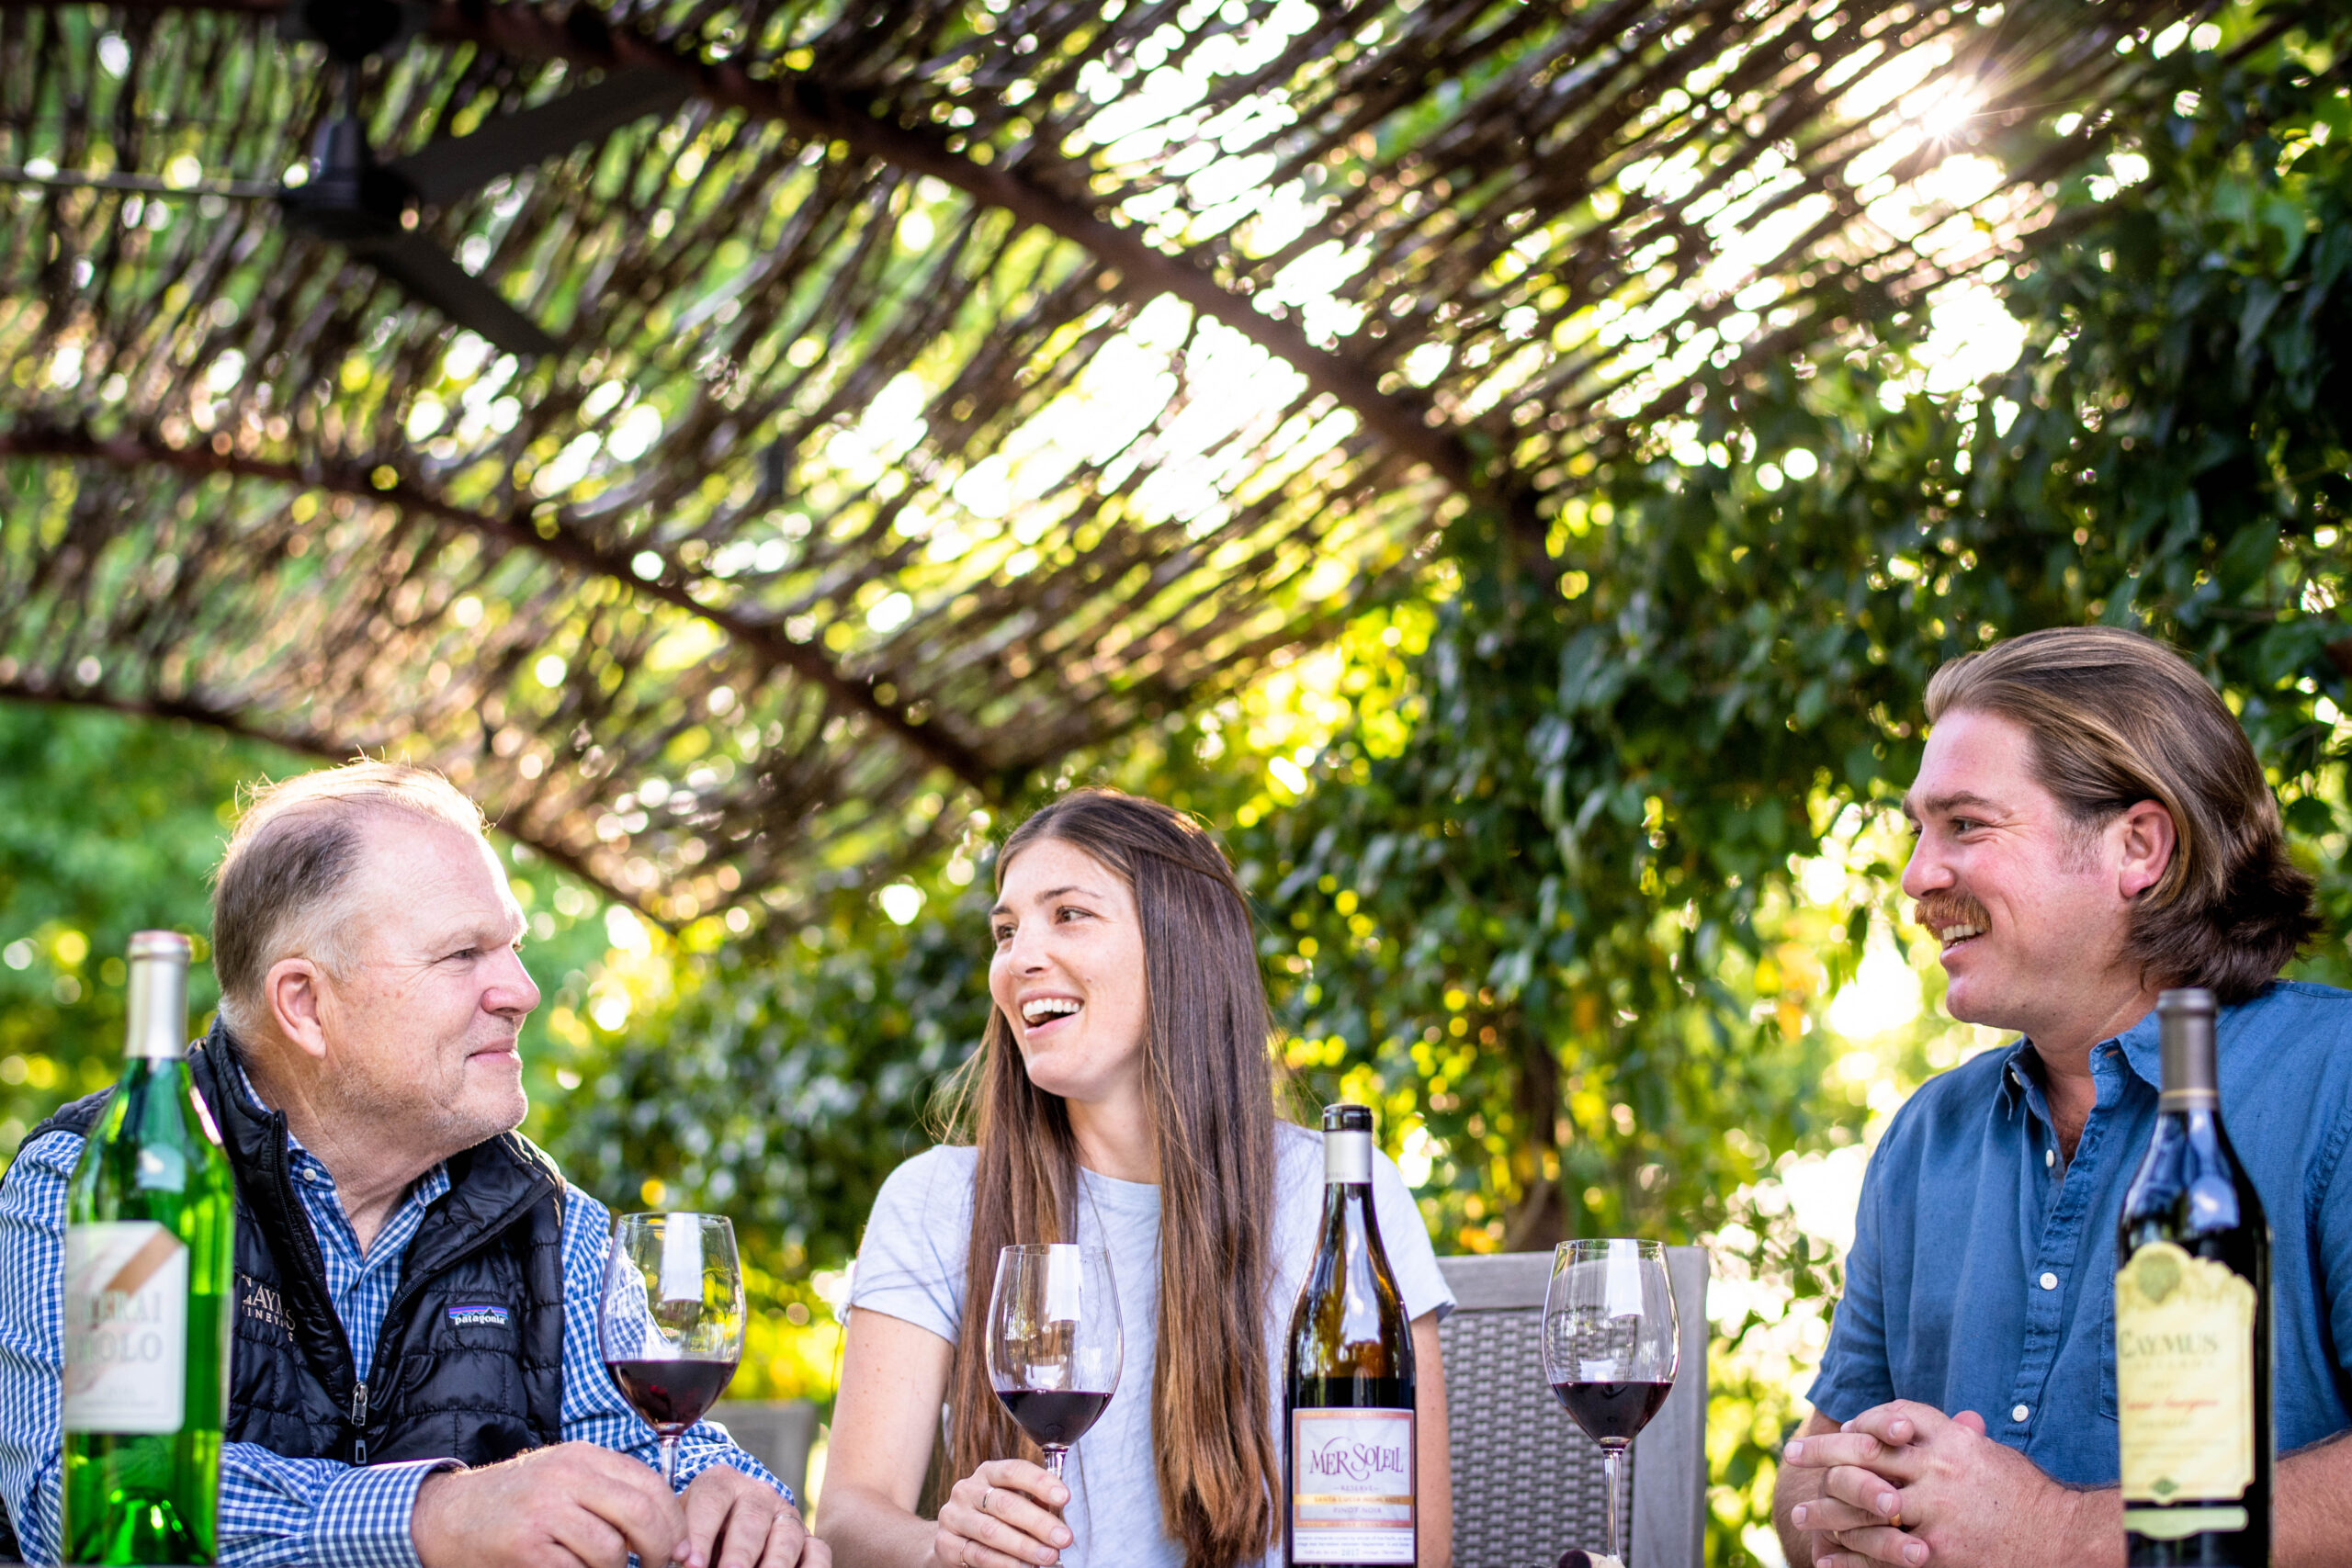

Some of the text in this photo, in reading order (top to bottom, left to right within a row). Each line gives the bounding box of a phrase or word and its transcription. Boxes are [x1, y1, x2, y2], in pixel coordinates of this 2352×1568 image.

[455, 1314, 506, 1325] patagonia
[1309, 1436, 1404, 1482] MER SOLEIL
[1340, 1484, 1374, 1493] RESERVE
